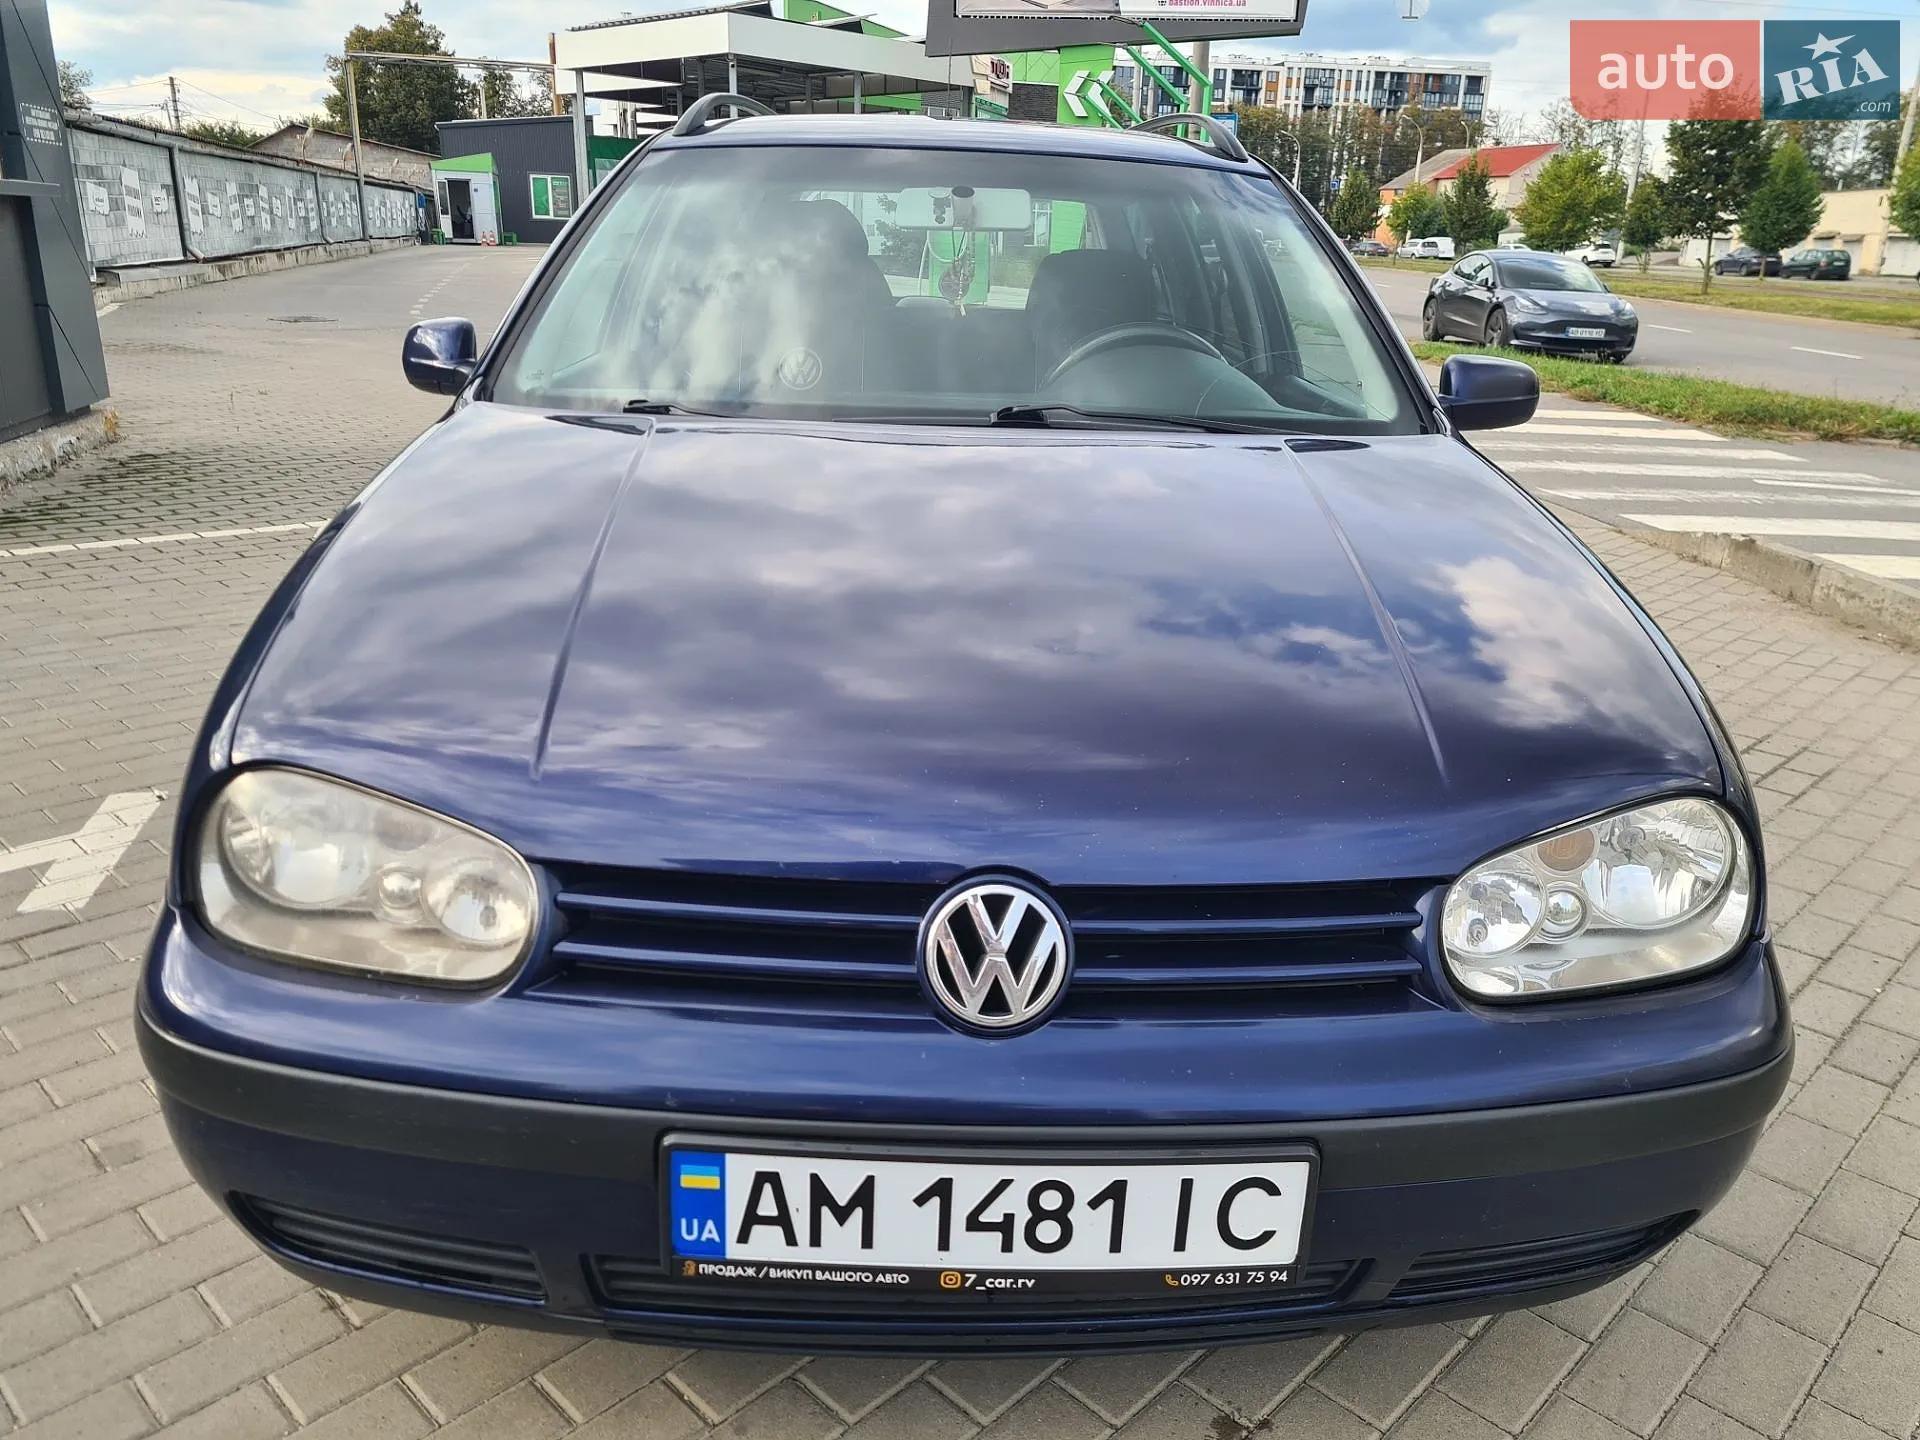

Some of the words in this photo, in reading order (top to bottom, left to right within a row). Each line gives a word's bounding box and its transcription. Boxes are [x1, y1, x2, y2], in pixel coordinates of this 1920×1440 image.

[929, 887, 1063, 1025] VW
[736, 1170, 876, 1250] AM
[912, 1176, 1129, 1254] 1481
[1172, 1175, 1282, 1252] IC
[680, 1217, 721, 1243] UA
[698, 1263, 757, 1278] ПРОДАЖ
[769, 1267, 813, 1281] ВИКУП
[815, 1269, 873, 1284] ВАШОГО
[875, 1272, 910, 1285] АВТО
[964, 1273, 1036, 1290] 7_car.rv
[1180, 1273, 1211, 1286] 097
[1214, 1272, 1241, 1285] 631
[1246, 1271, 1265, 1284] 75
[1269, 1270, 1288, 1283] 94
